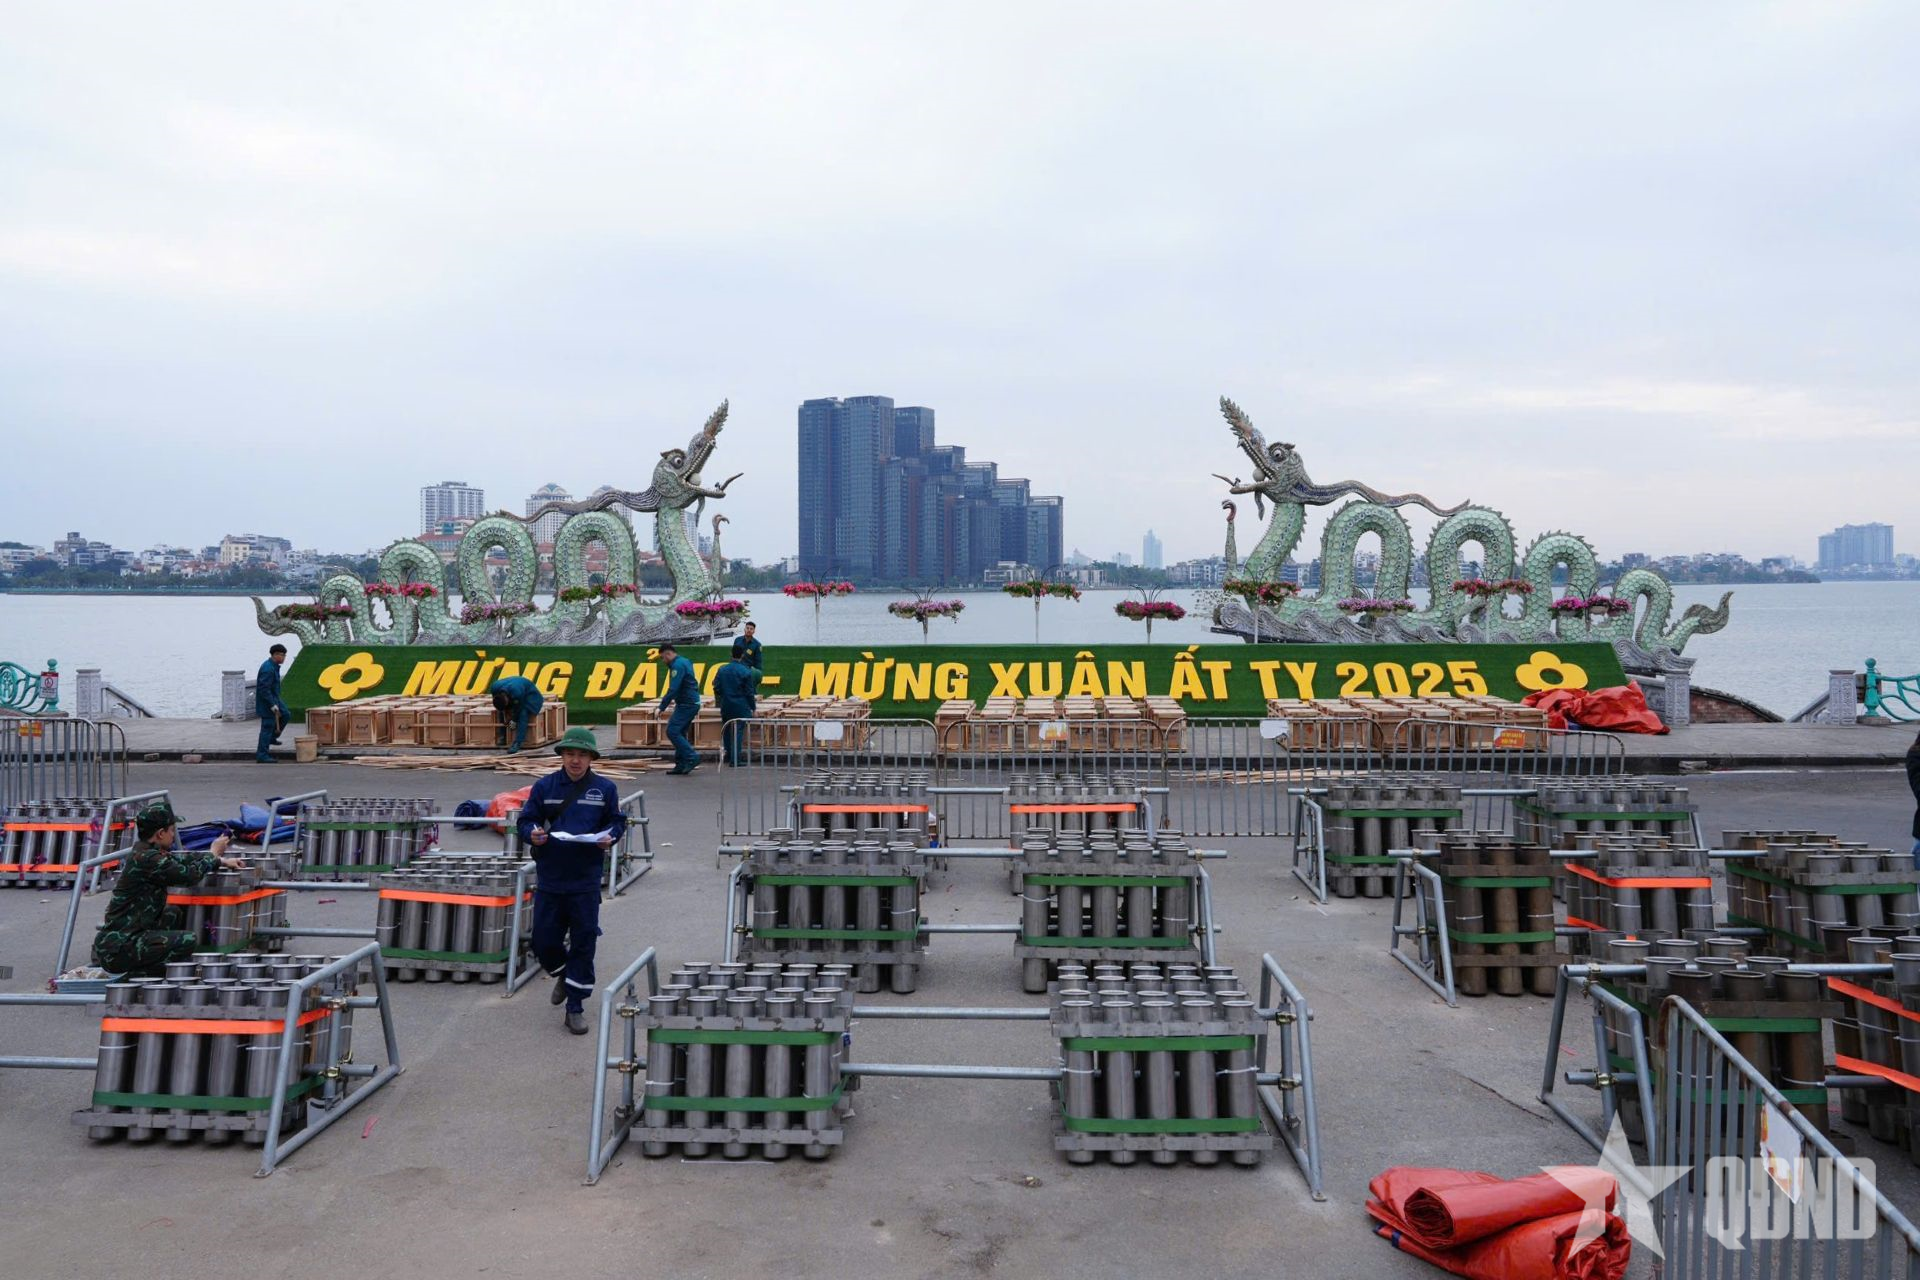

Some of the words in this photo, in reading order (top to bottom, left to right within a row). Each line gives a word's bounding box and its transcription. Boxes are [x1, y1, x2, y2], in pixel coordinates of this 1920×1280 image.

[584, 648, 732, 698] ĐẢ
[799, 651, 969, 701] MỪNG
[989, 650, 1147, 700] XUÂN
[1170, 645, 1232, 700] ẤT
[1336, 661, 1488, 697] 2025
